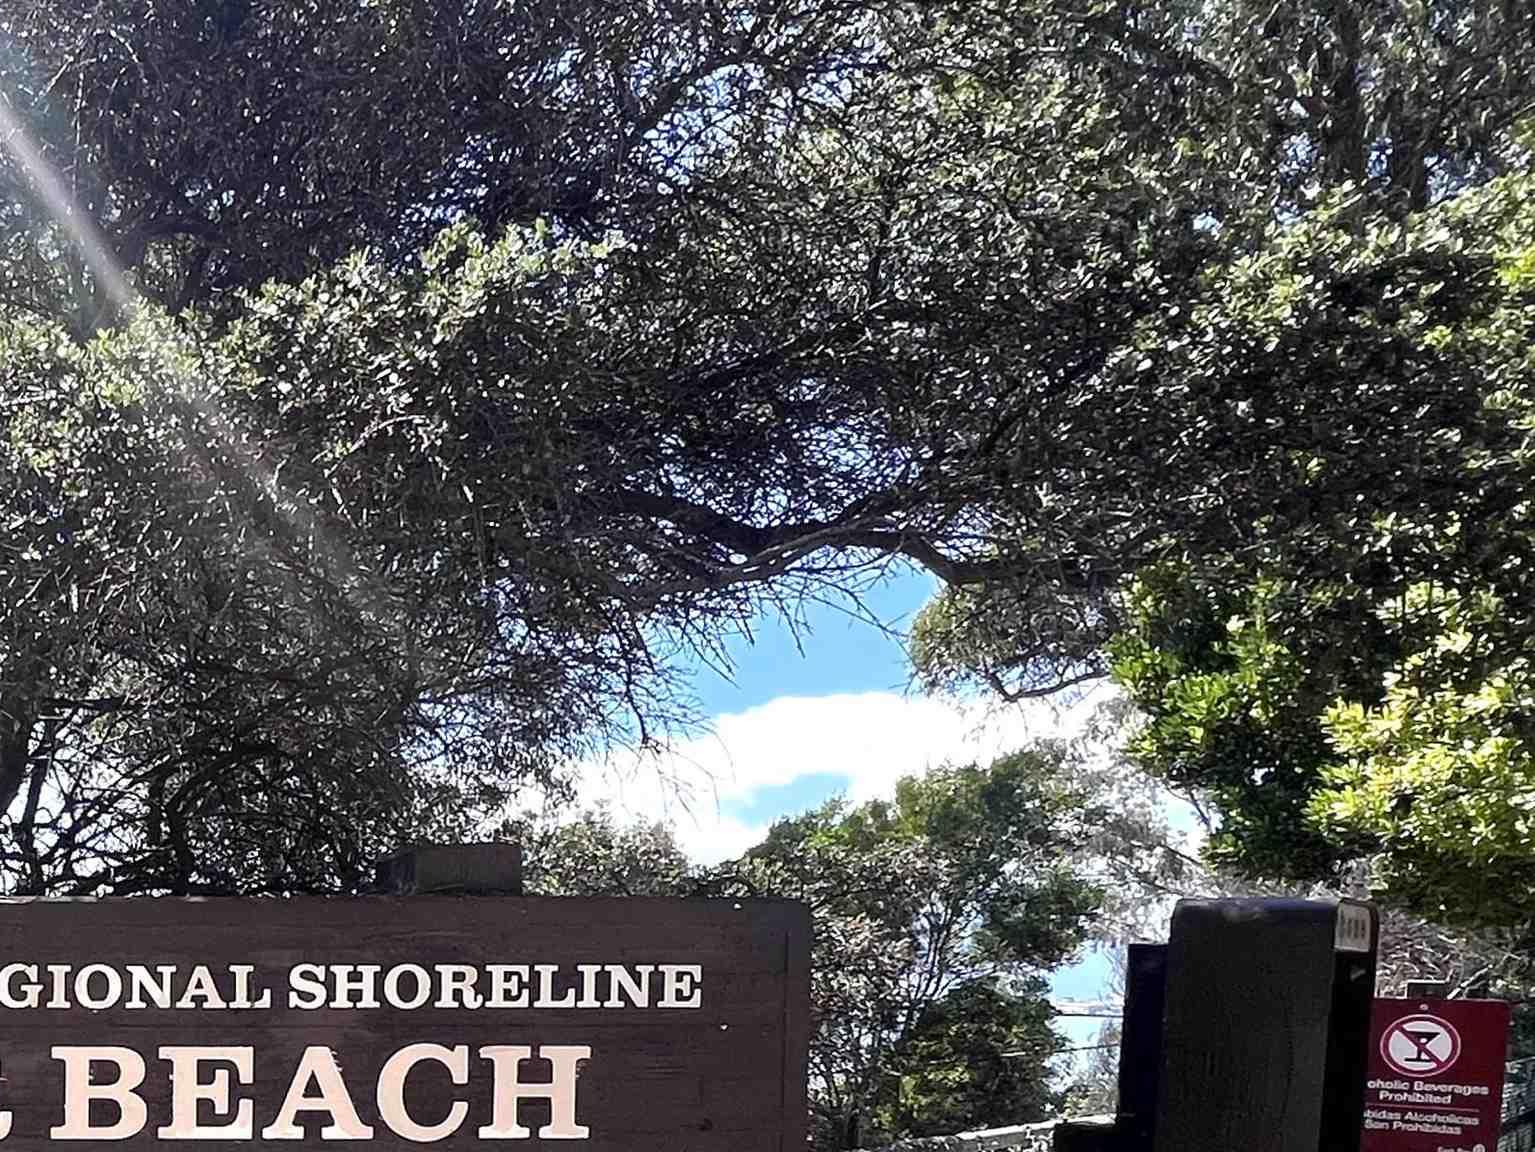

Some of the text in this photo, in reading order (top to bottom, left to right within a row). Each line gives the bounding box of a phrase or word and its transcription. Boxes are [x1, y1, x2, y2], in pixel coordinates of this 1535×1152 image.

[288, 963, 702, 1010] SHORELINE
[50, 1042, 592, 1143] BEACH
[1367, 1079, 1489, 1096] oholic Beverages
[1379, 1090, 1452, 1104] Prohibited
[1392, 1121, 1462, 1136] Prohibidas
